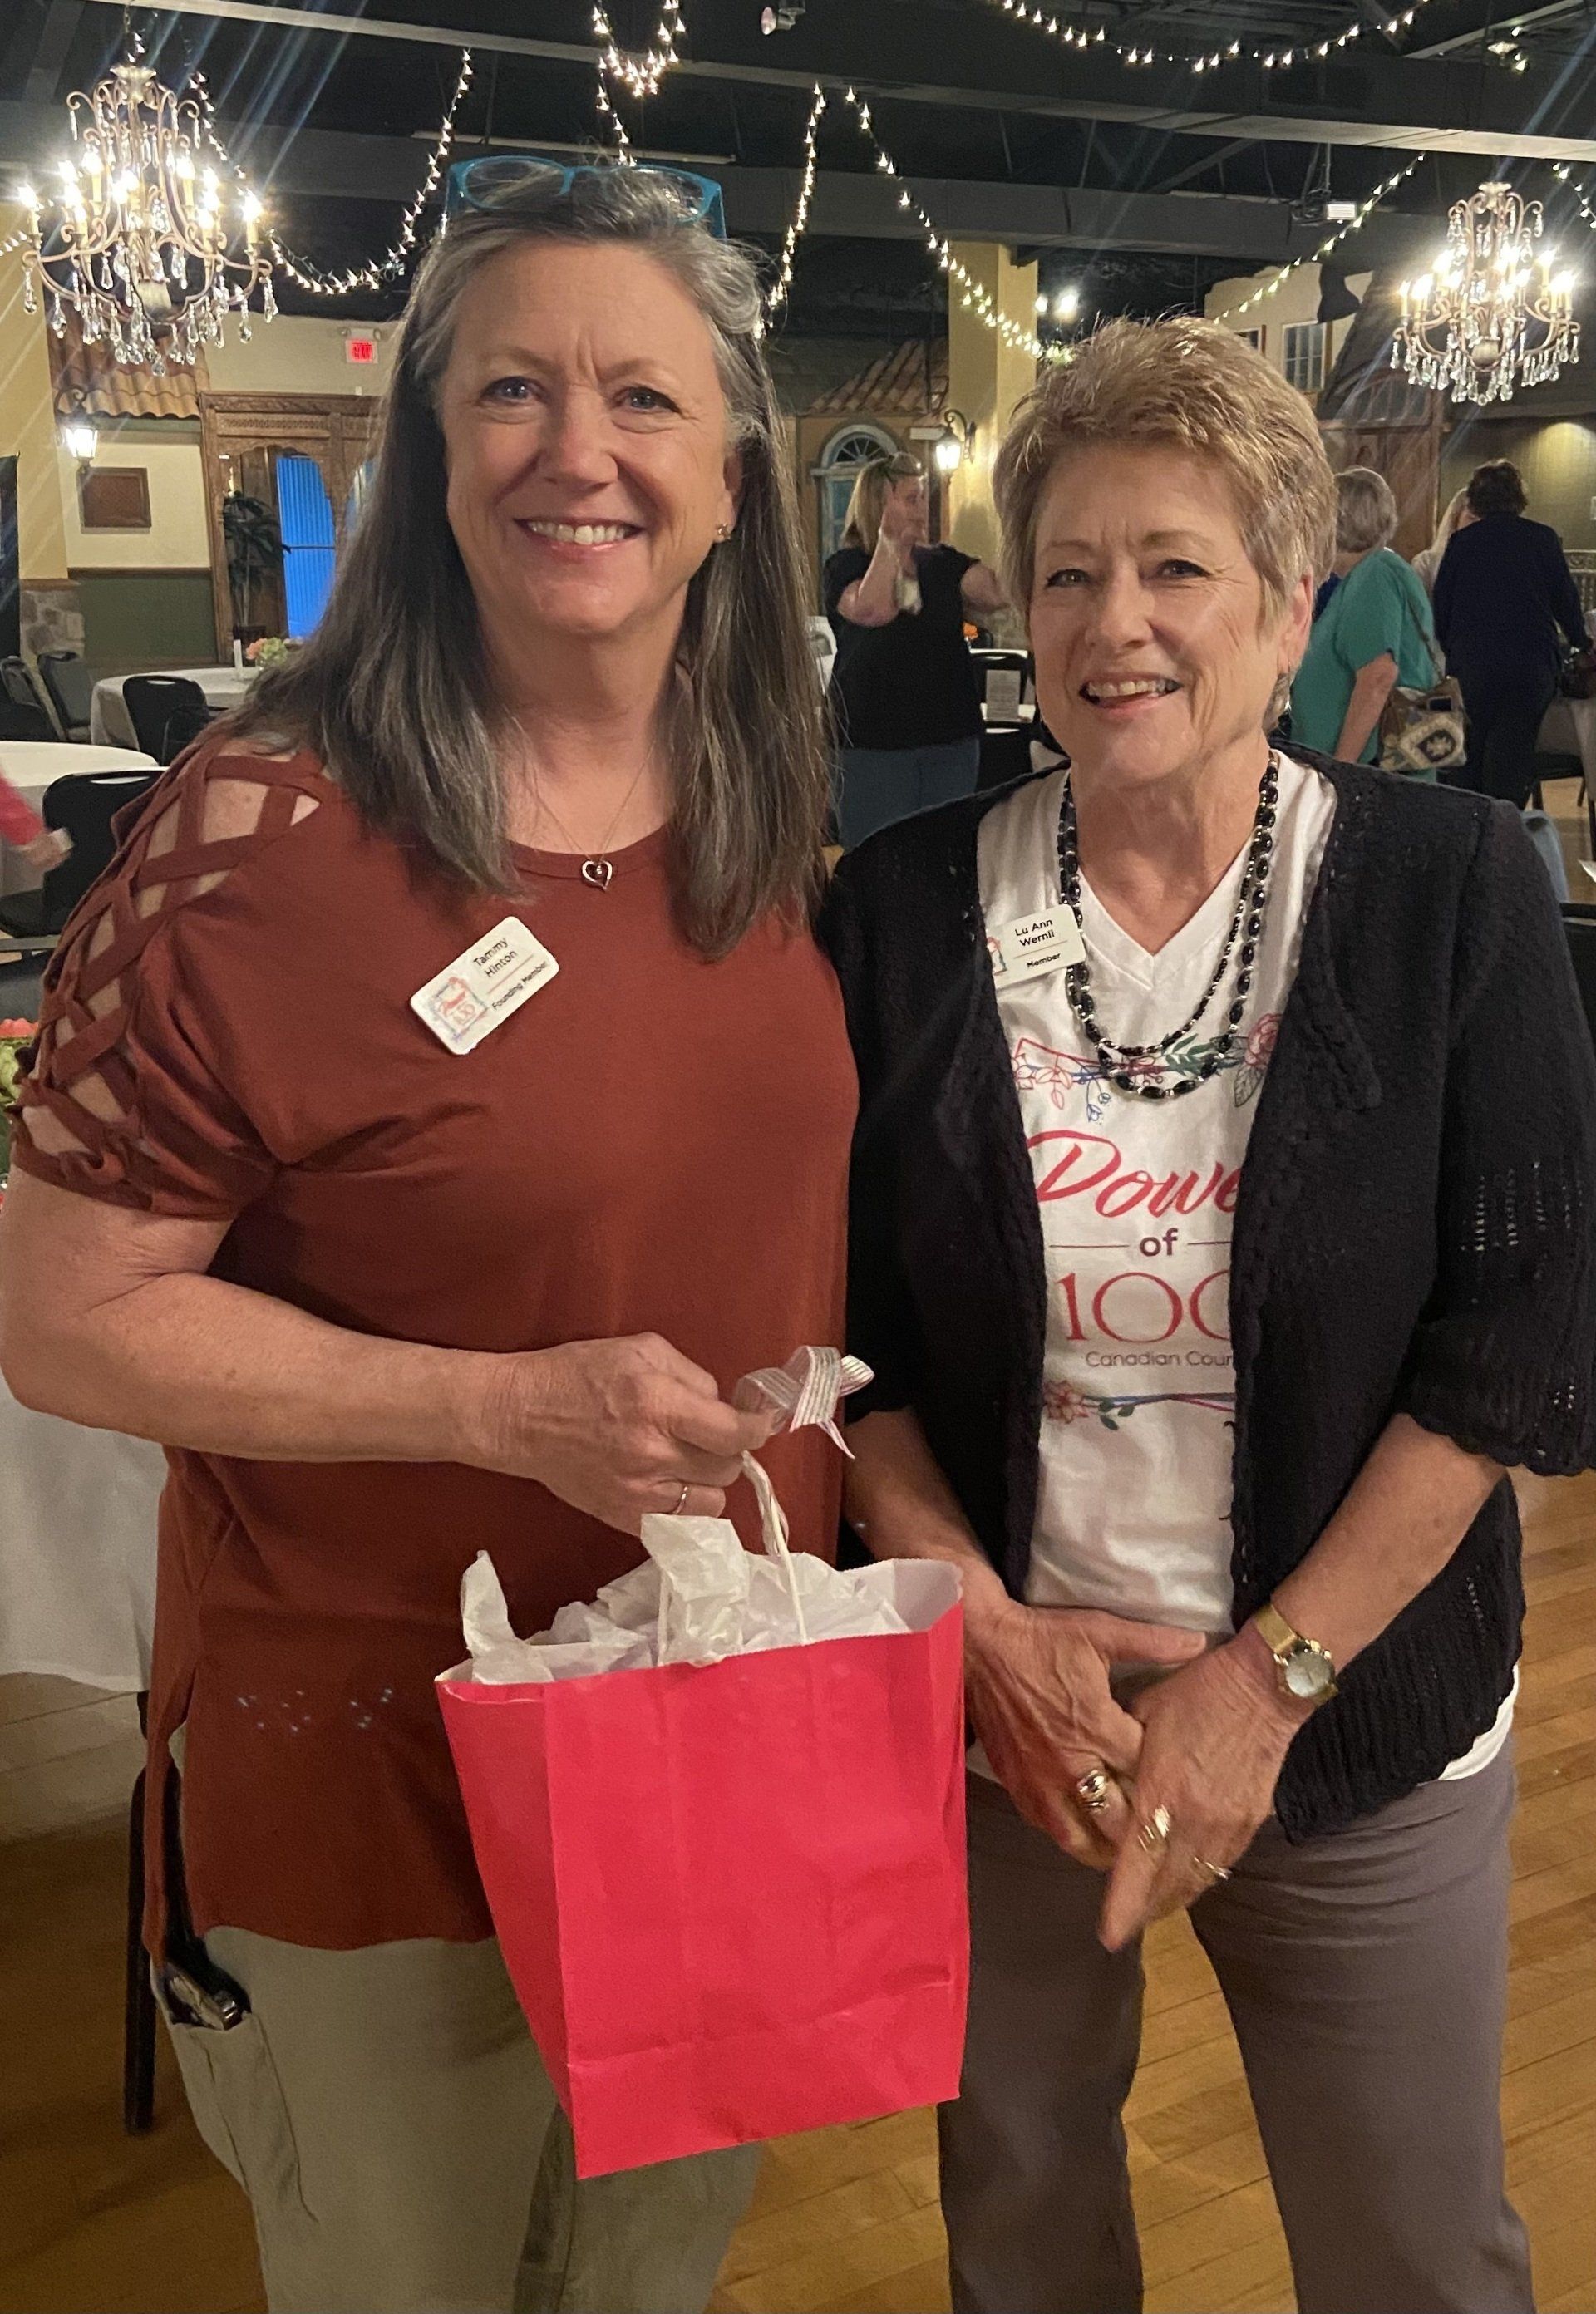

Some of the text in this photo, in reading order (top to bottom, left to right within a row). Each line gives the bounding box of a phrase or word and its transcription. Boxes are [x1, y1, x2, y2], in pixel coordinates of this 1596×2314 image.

[1014, 919, 1053, 937] Lu Ann
[473, 938, 509, 967] Tammy
[485, 950, 517, 977] Hinton
[1027, 953, 1061, 968] Member
[491, 982, 523, 1009] Founding
[521, 961, 547, 983] Member
[1139, 1228, 1179, 1257] of
[1085, 1351, 1181, 1367] Canadian
